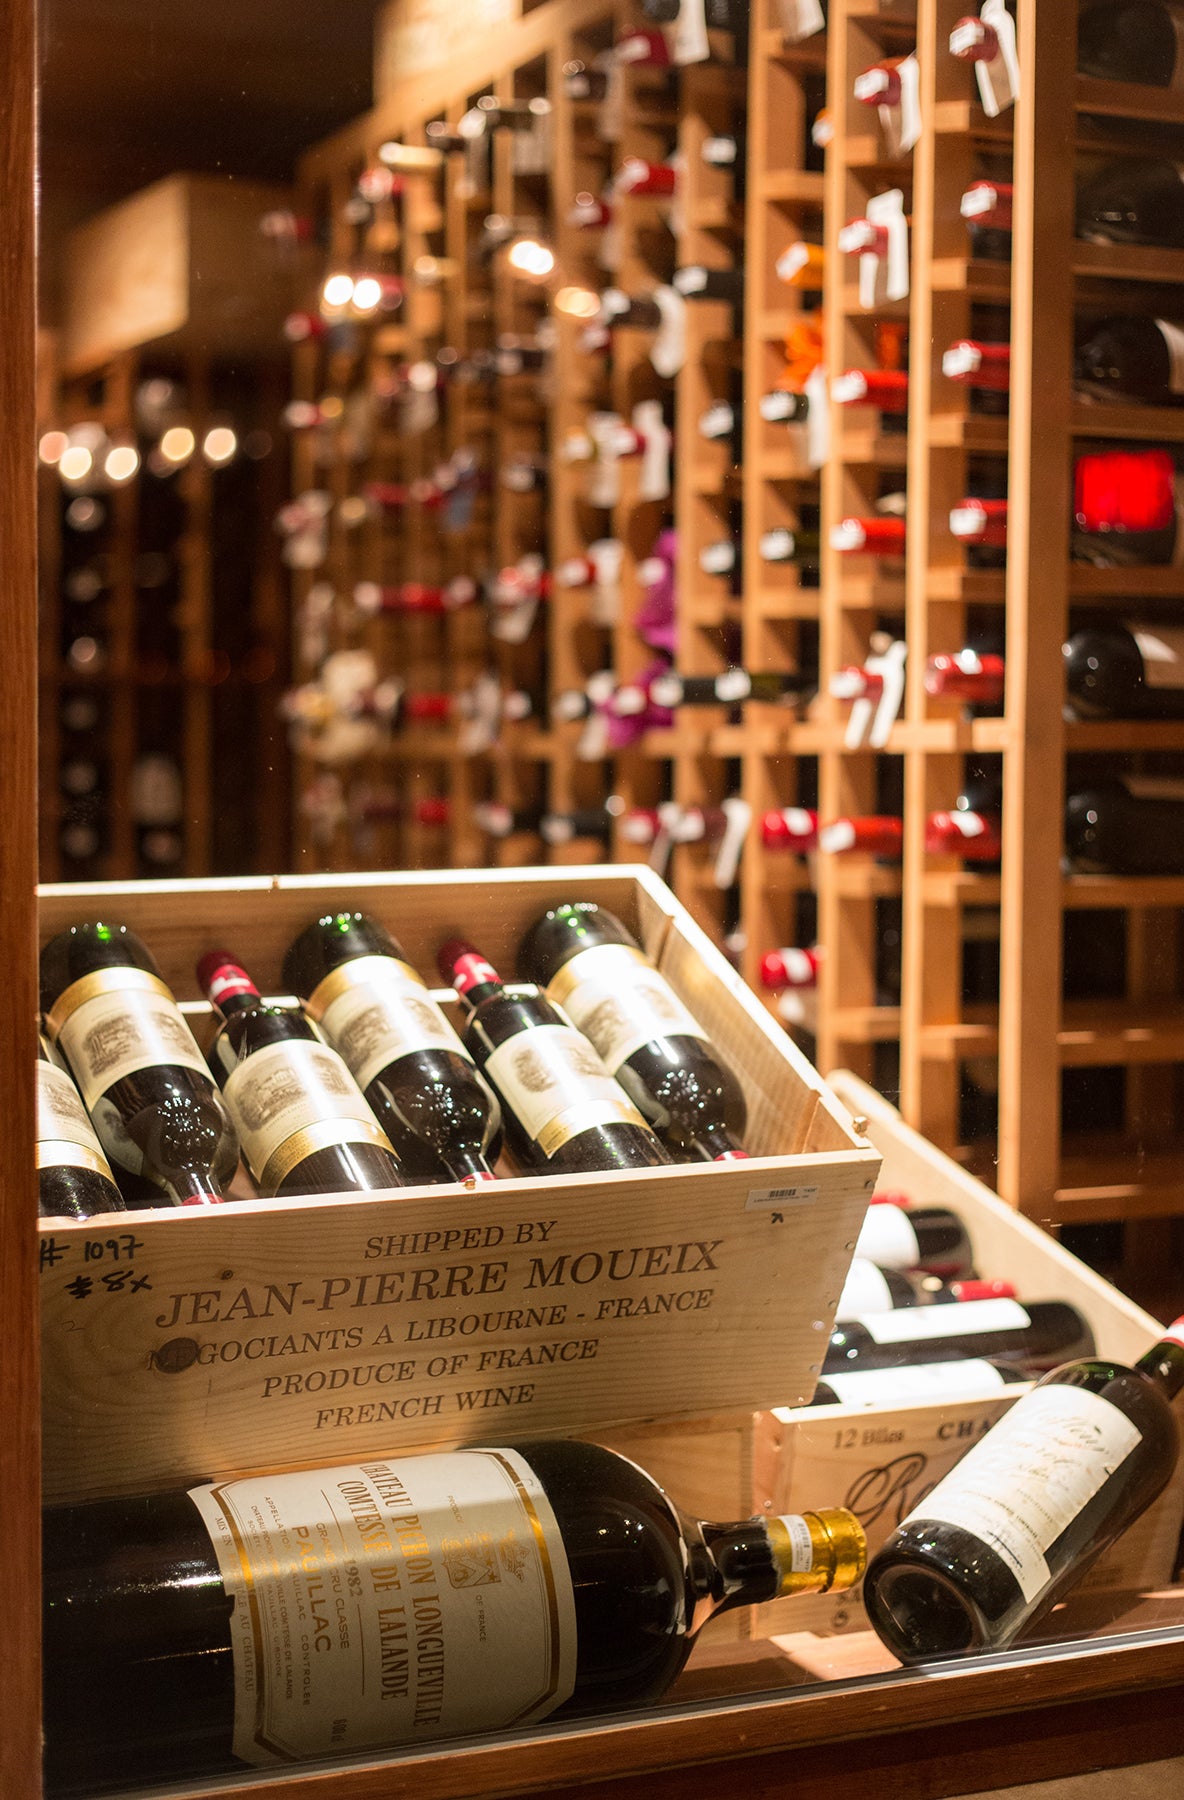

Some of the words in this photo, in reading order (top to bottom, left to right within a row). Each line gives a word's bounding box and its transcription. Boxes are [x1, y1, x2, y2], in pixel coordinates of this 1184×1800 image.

[85, 1235, 144, 1262] 1097
[364, 1226, 504, 1259] SHIPPED
[513, 1221, 557, 1245] BY
[155, 1261, 508, 1328] JEAN-PIERRE
[523, 1240, 724, 1290] MOUEIX
[372, 1324, 394, 1345] A
[404, 1305, 567, 1341] LIBOURNE
[594, 1289, 714, 1320] FRANCE
[261, 1361, 415, 1398] PRODUCE
[427, 1354, 468, 1377] OF
[476, 1339, 600, 1372] FRANCE
[314, 1395, 445, 1429] FRENCH
[456, 1384, 535, 1411] WINE
[834, 1428, 859, 1450] 12
[360, 1464, 413, 1508] CHATEAU
[215, 1516, 227, 1532] MIS
[337, 1480, 393, 1552] COMTESSE
[222, 1534, 233, 1547] EN
[315, 1522, 337, 1563] GRAND
[391, 1514, 437, 1585] PICHON
[292, 1526, 332, 1652] PAUILLAC
[329, 1566, 342, 1593] CRU
[344, 1559, 363, 1597] 1982
[370, 1564, 402, 1593] DE
[239, 1614, 250, 1630] AU
[335, 1597, 350, 1649] CLASSE
[478, 1609, 487, 1642] FRANCE
[241, 1636, 255, 1692] CHATEAU
[377, 1605, 409, 1701] LALANDE
[411, 1594, 445, 1728] LONGUEVILLE
